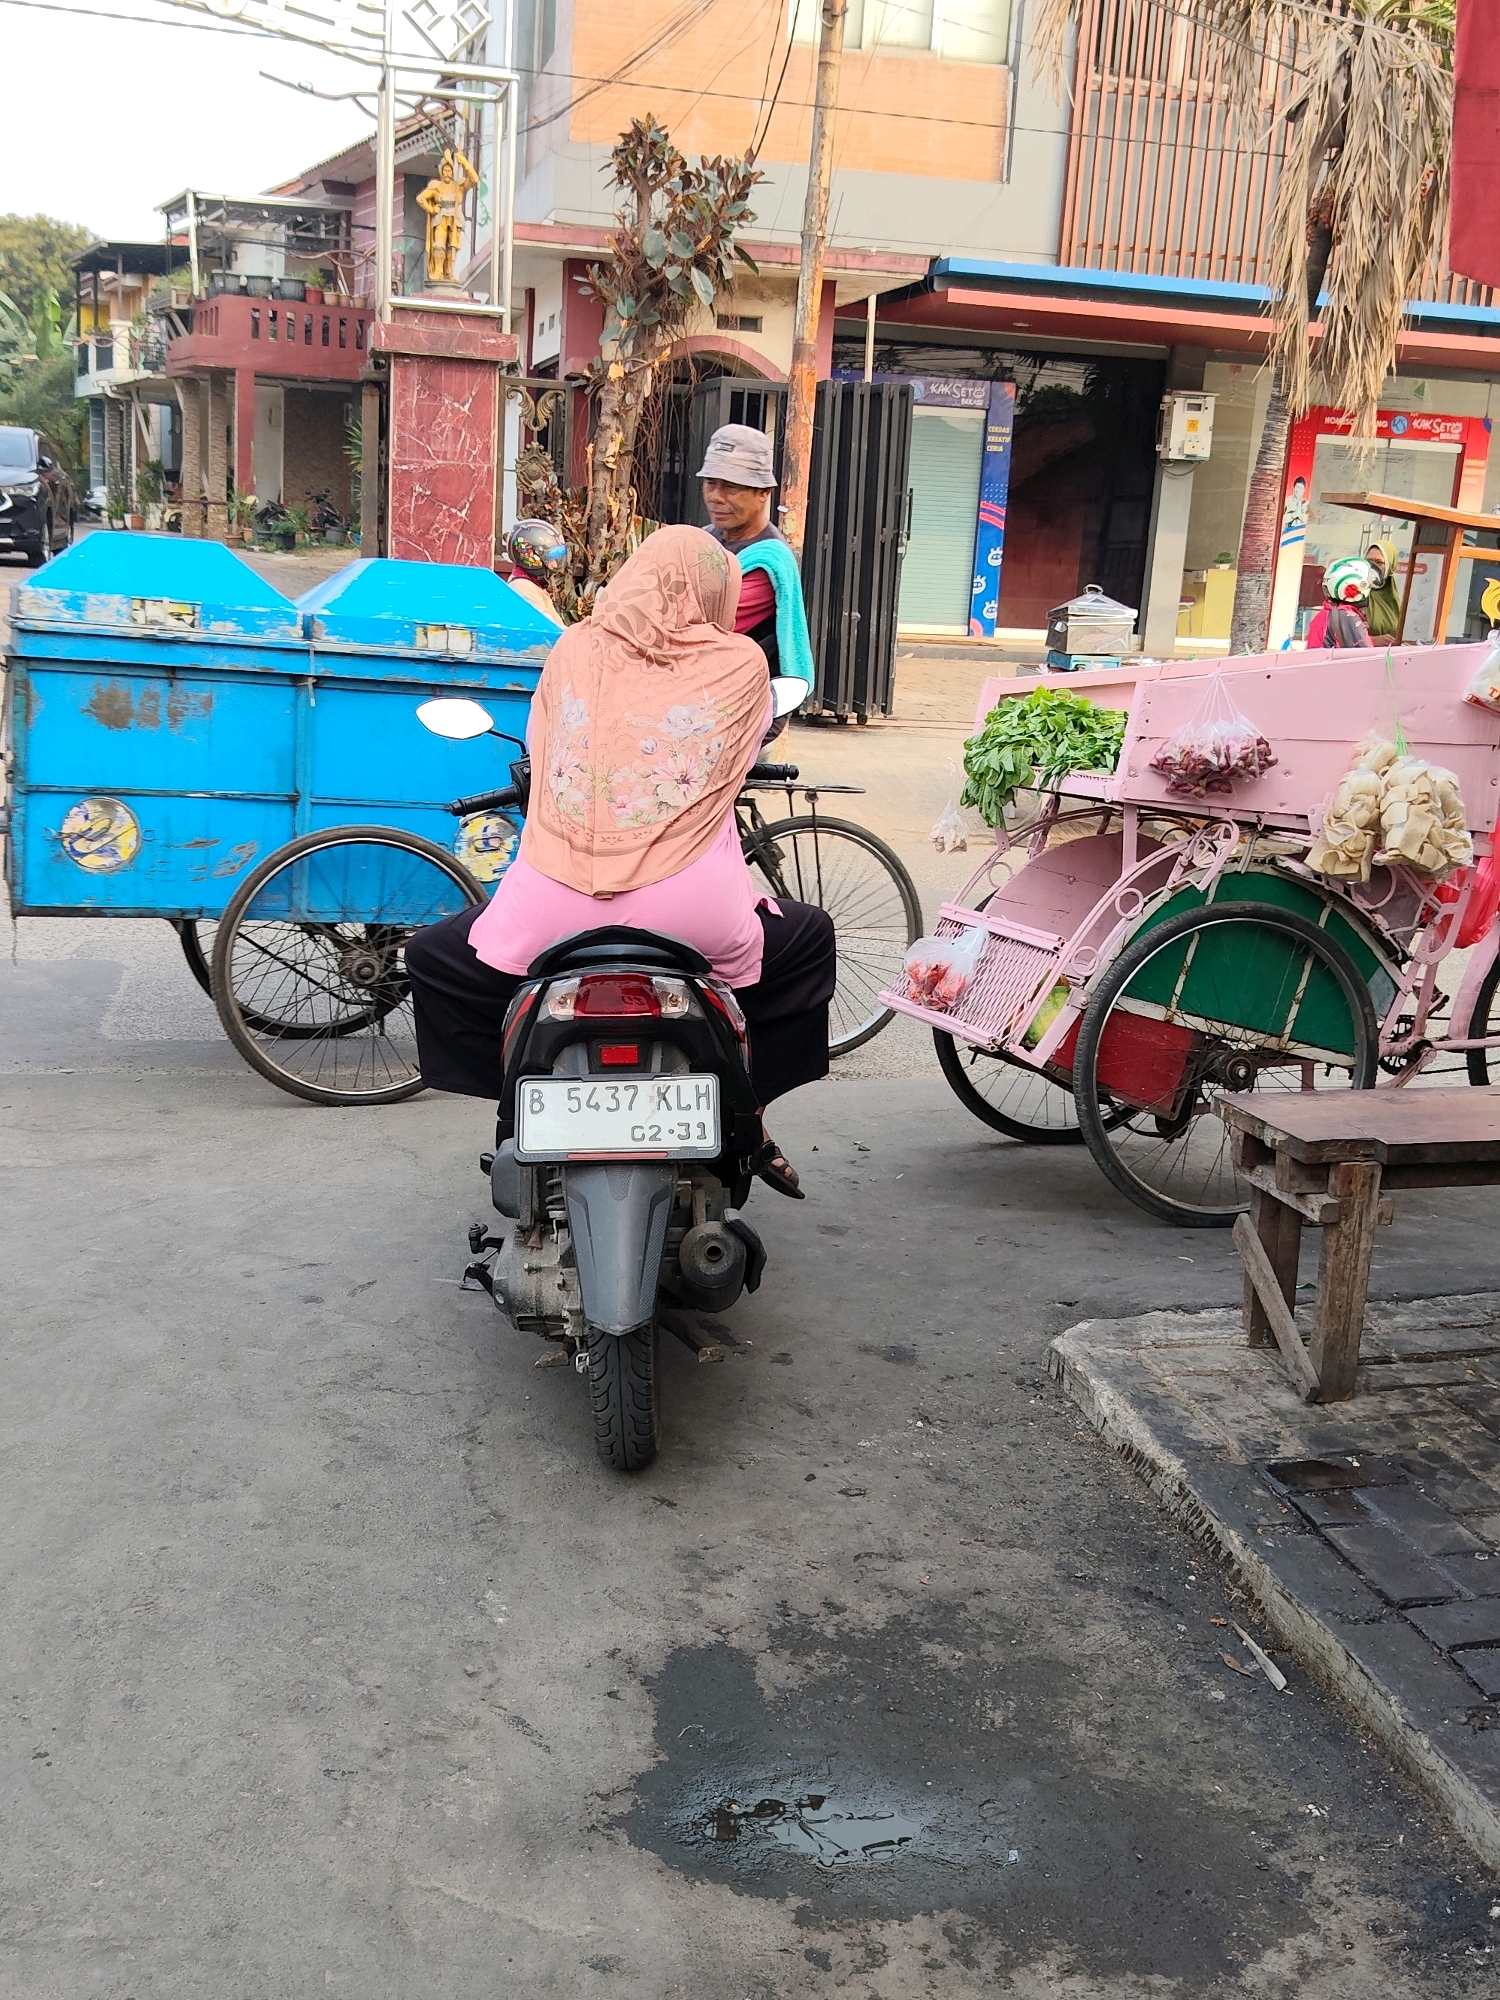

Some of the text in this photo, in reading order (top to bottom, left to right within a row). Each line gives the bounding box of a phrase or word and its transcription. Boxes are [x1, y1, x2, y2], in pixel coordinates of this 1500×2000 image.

[930, 383, 953, 395] KAK
[1412, 418, 1433, 431] KAK
[529, 1084, 711, 1115] B 5437 KLH
